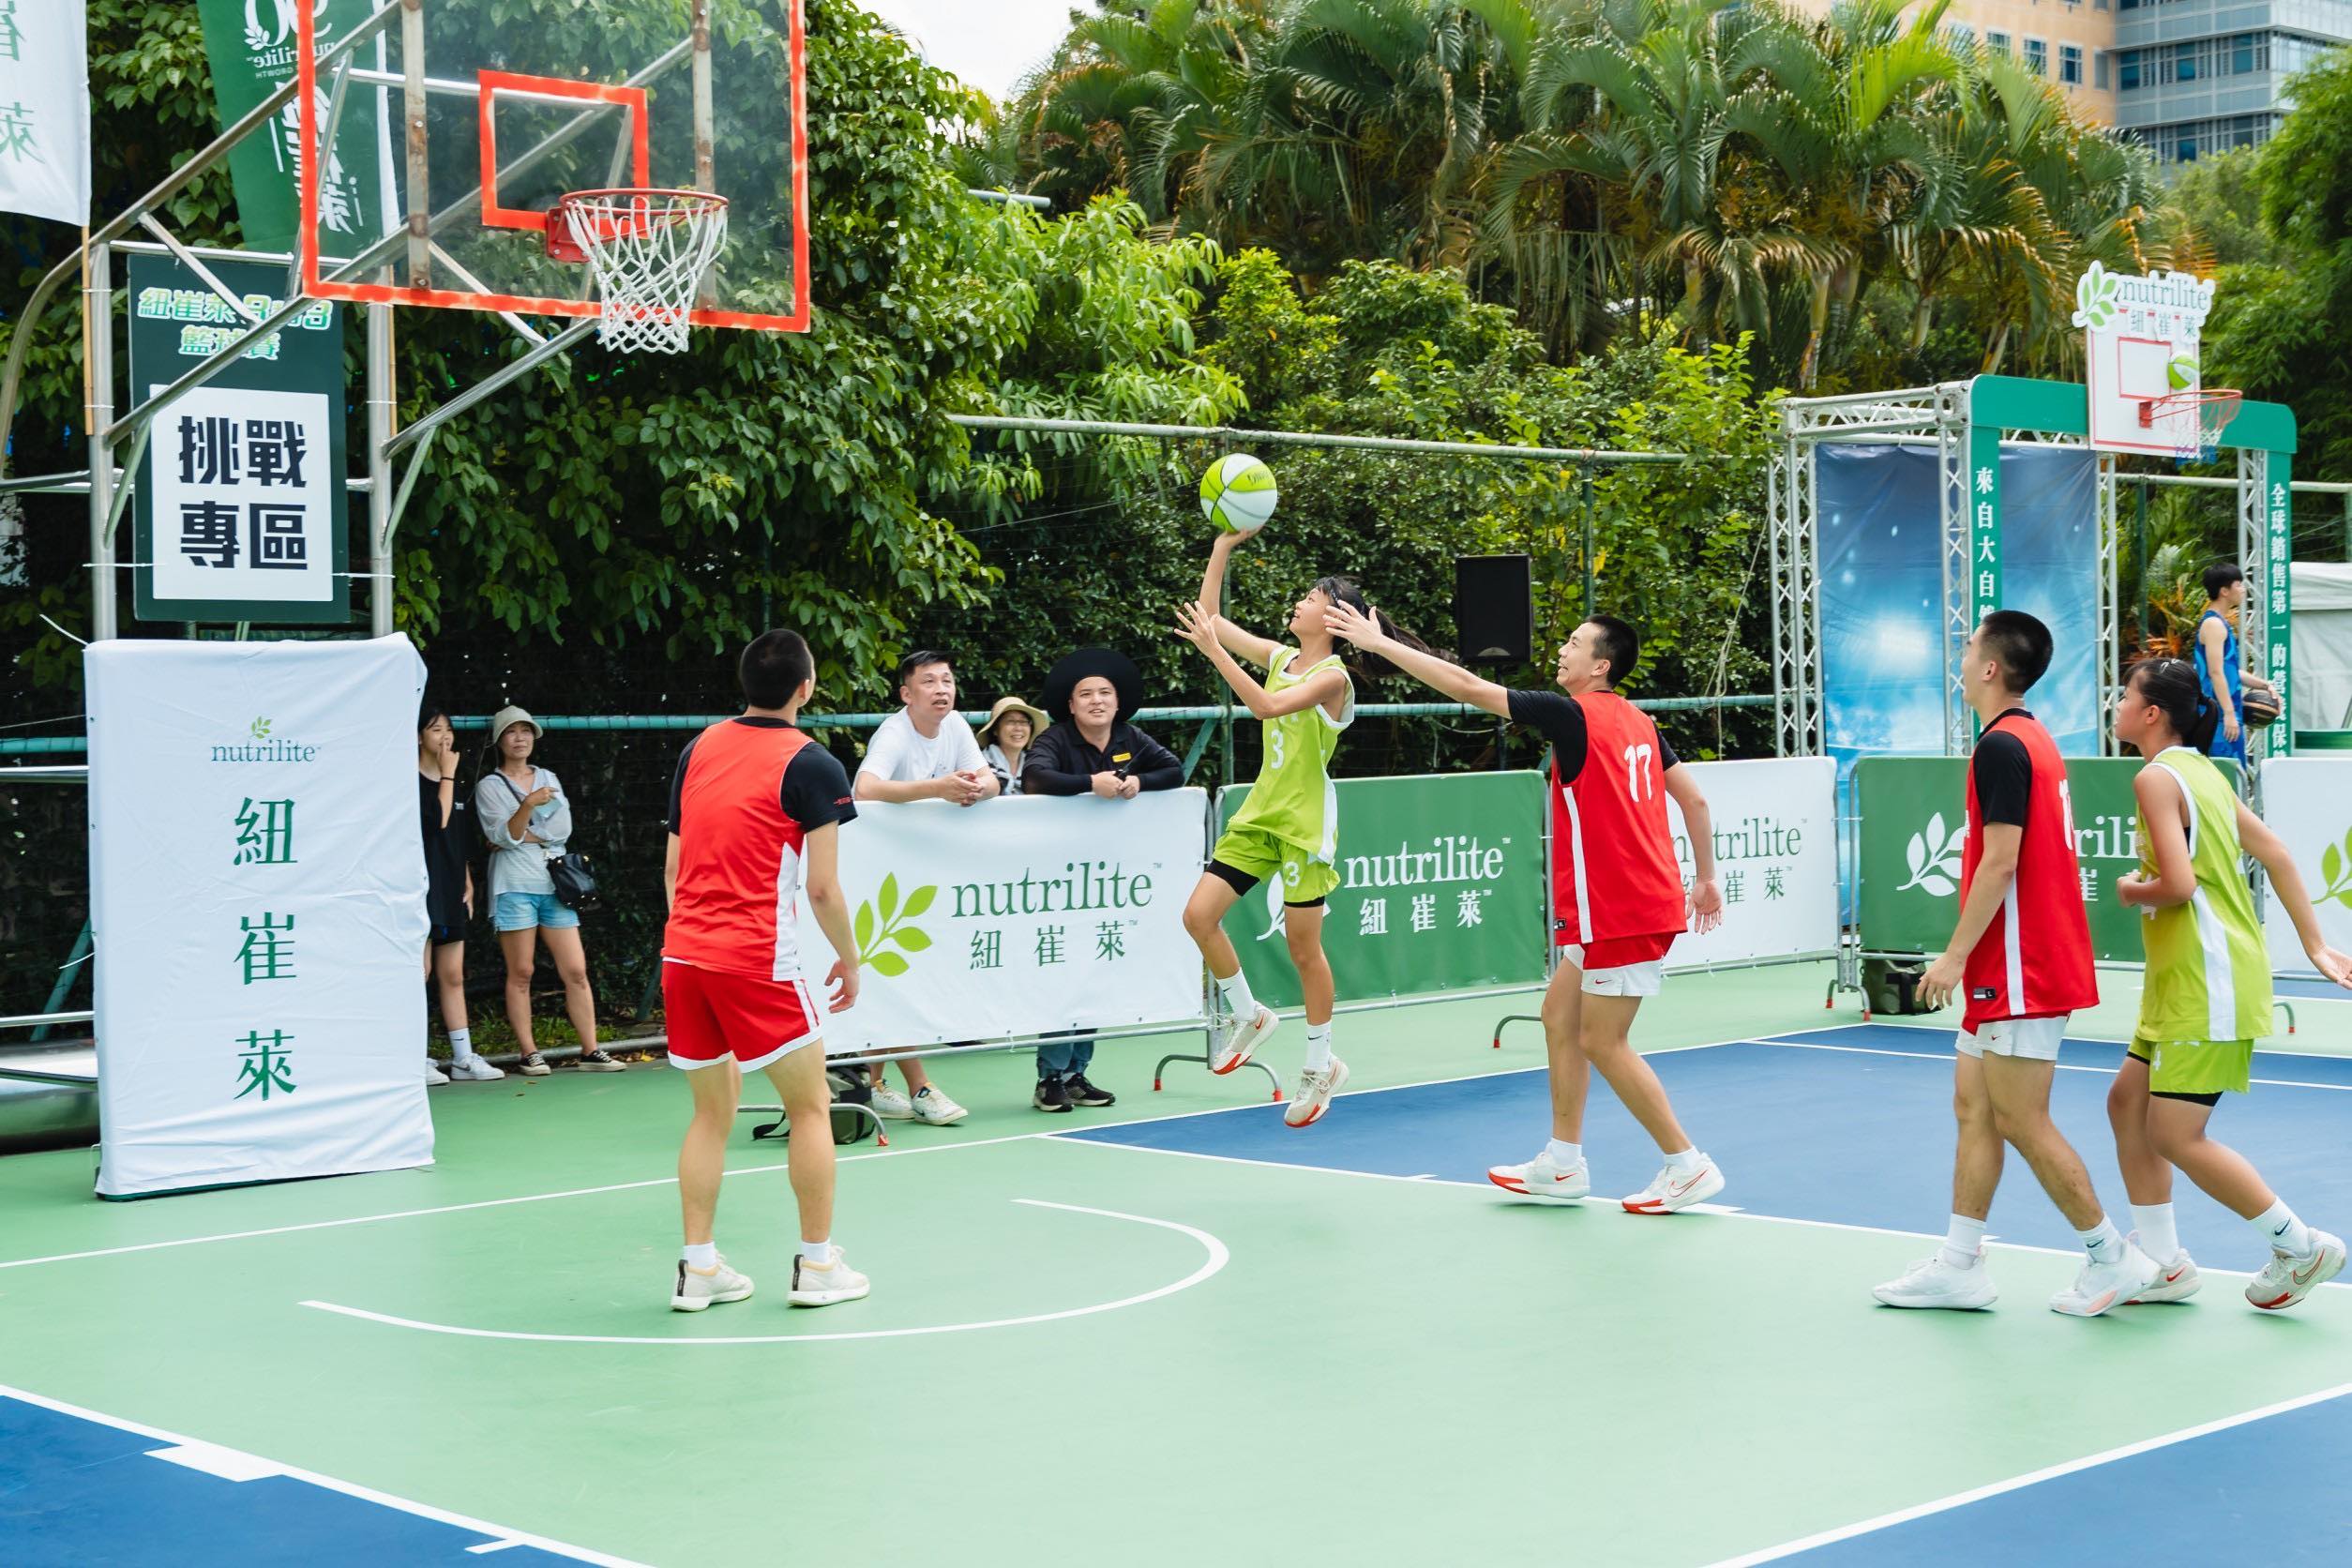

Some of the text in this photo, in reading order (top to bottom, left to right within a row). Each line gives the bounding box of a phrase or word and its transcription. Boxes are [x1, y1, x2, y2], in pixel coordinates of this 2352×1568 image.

[2122, 278, 2208, 310] nutrilite
[178, 415, 308, 488] 挑戰
[180, 501, 309, 570] 專區
[211, 739, 315, 762] nutrilite
[1271, 729, 1284, 769] 3
[1623, 744, 1651, 802] 17
[1344, 836, 1504, 888] nutrilite
[1673, 817, 1802, 863] ntrilite
[951, 861, 1153, 917] nutrilite
[1284, 861, 1300, 887] 3
[1359, 889, 1484, 936] 紐崔萊
[233, 797, 298, 1101] 紐崔萊
[970, 921, 1125, 970] 紐崔萊
